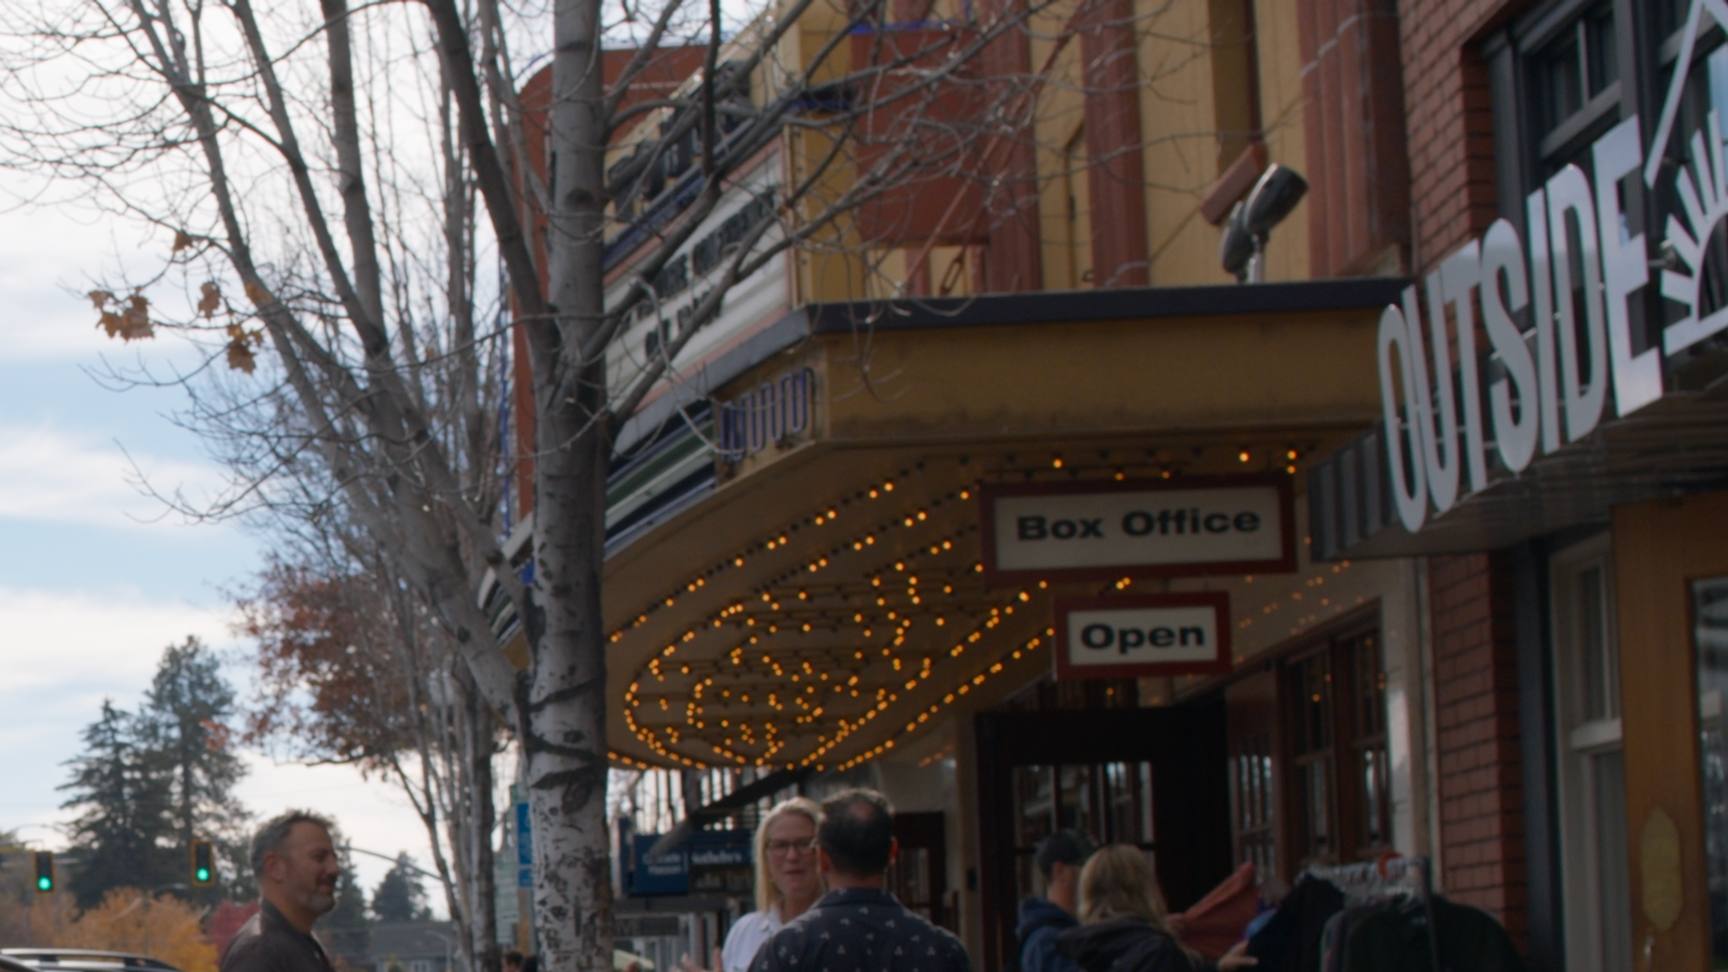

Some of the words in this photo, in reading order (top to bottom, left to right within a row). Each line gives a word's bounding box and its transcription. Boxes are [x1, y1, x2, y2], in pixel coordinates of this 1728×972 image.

[1378, 114, 1663, 533] OUTSIDE
[1017, 515, 1105, 540] Box
[1122, 508, 1261, 536] Office
[1081, 623, 1204, 654] Open
